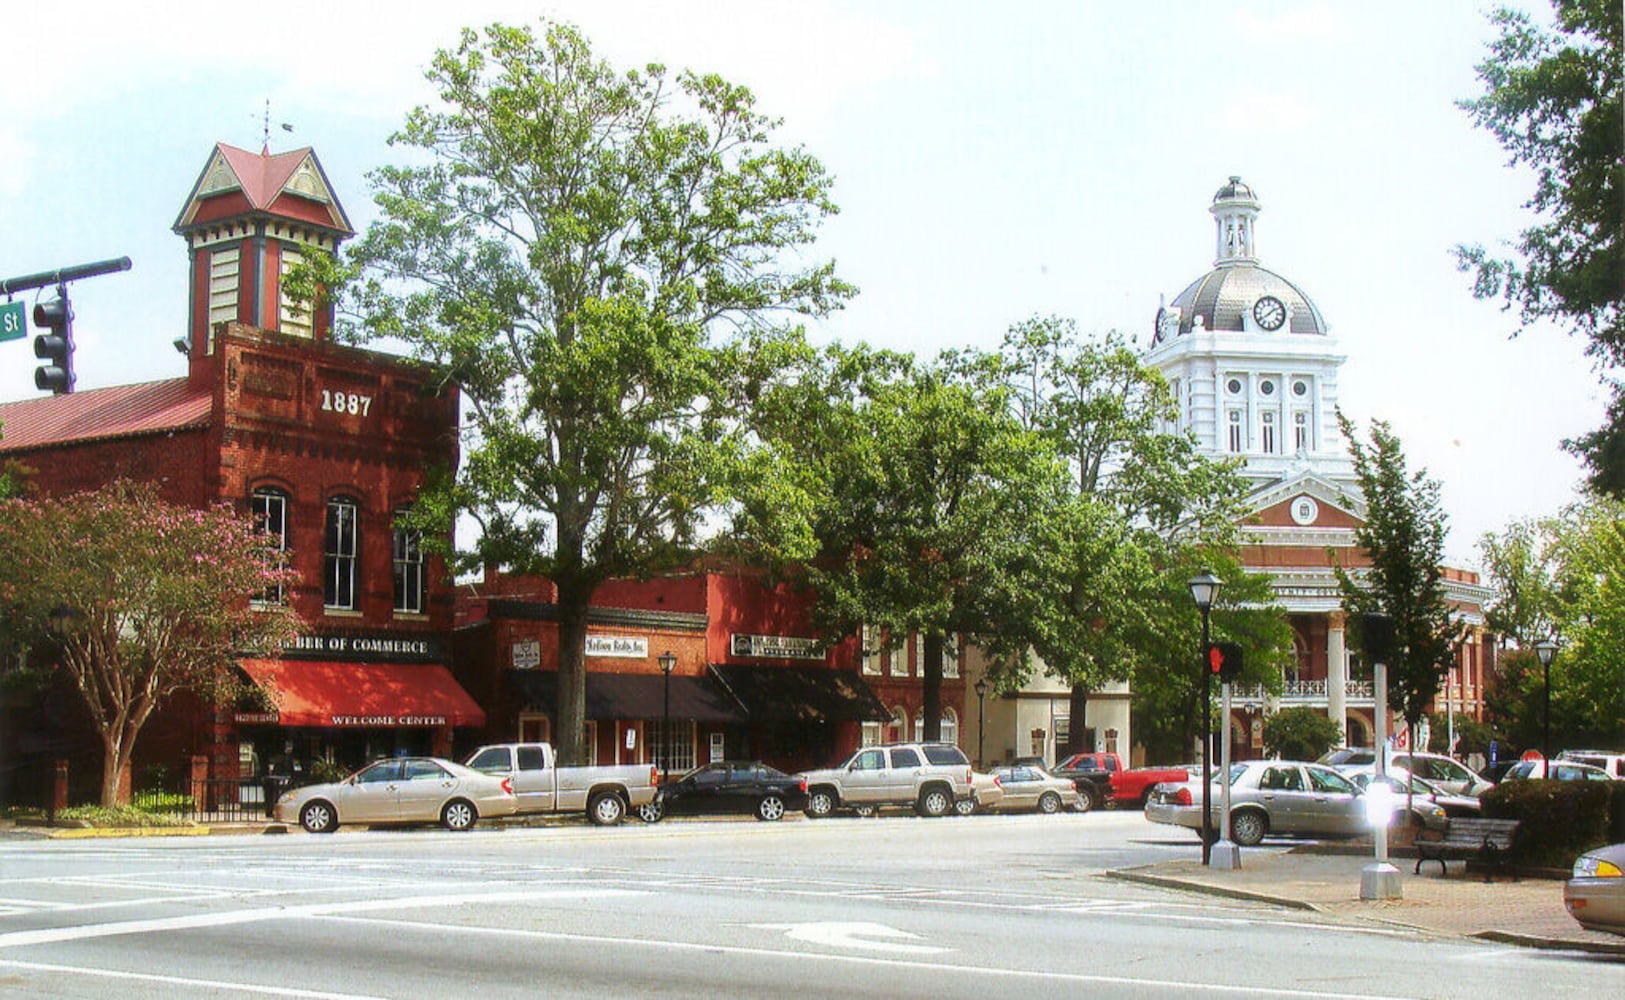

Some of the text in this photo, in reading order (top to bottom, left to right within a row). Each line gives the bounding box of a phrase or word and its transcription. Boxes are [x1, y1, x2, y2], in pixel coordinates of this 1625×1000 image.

[4, 312, 18, 332] St
[321, 389, 371, 417] 1887
[252, 636, 428, 653] CMBER OF COMMERCE
[332, 716, 446, 725] WELCOME CENTER
